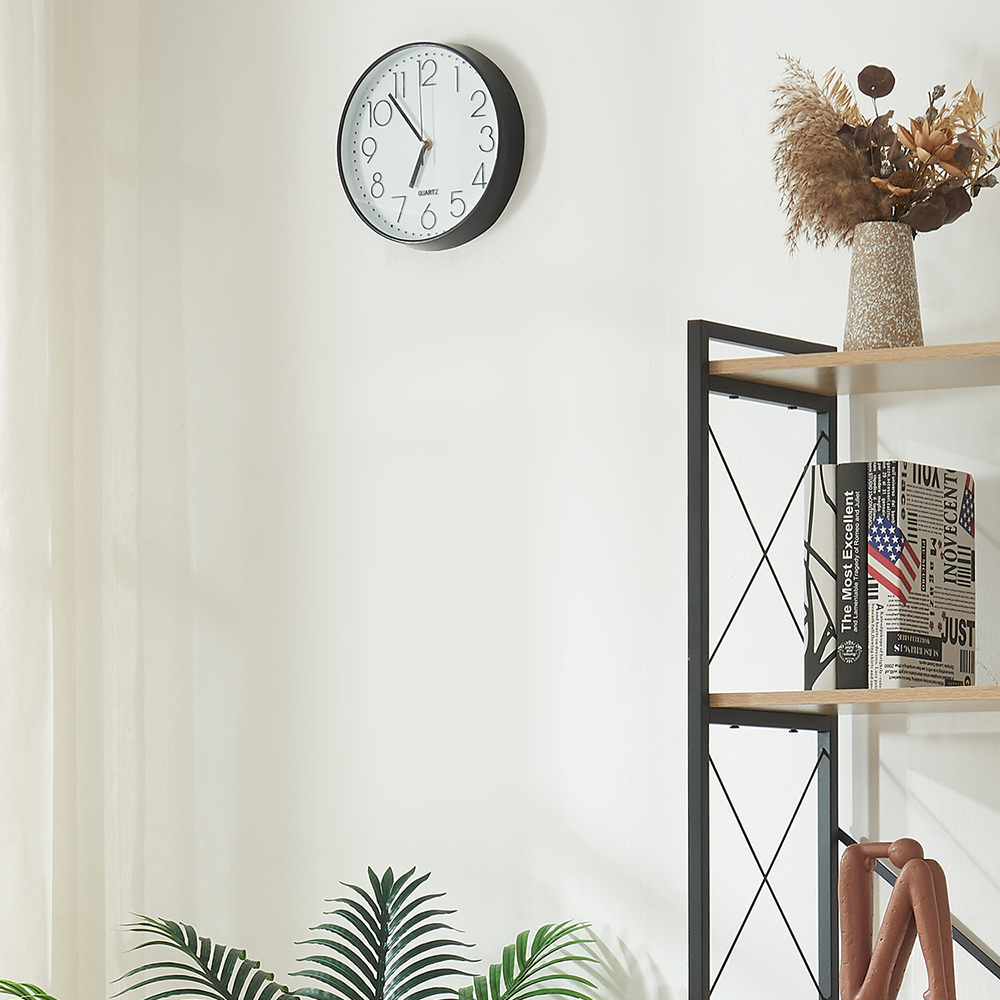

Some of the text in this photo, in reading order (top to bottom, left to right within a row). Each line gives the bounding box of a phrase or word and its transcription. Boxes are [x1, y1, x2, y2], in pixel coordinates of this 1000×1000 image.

[393, 72, 405, 99] 11
[417, 59, 437, 86] 12
[454, 66, 459, 93] 1
[367, 100, 392, 127] 10
[470, 90, 486, 118] 2
[362, 137, 377, 164] 9
[479, 126, 494, 152] 3
[371, 172, 384, 198] 8
[472, 163, 487, 189] 4
[391, 196, 406, 223] 7
[421, 203, 436, 229] 6
[450, 191, 465, 217] 5
[841, 491, 854, 633] The Most Excellent
[941, 617, 975, 647] JUST
